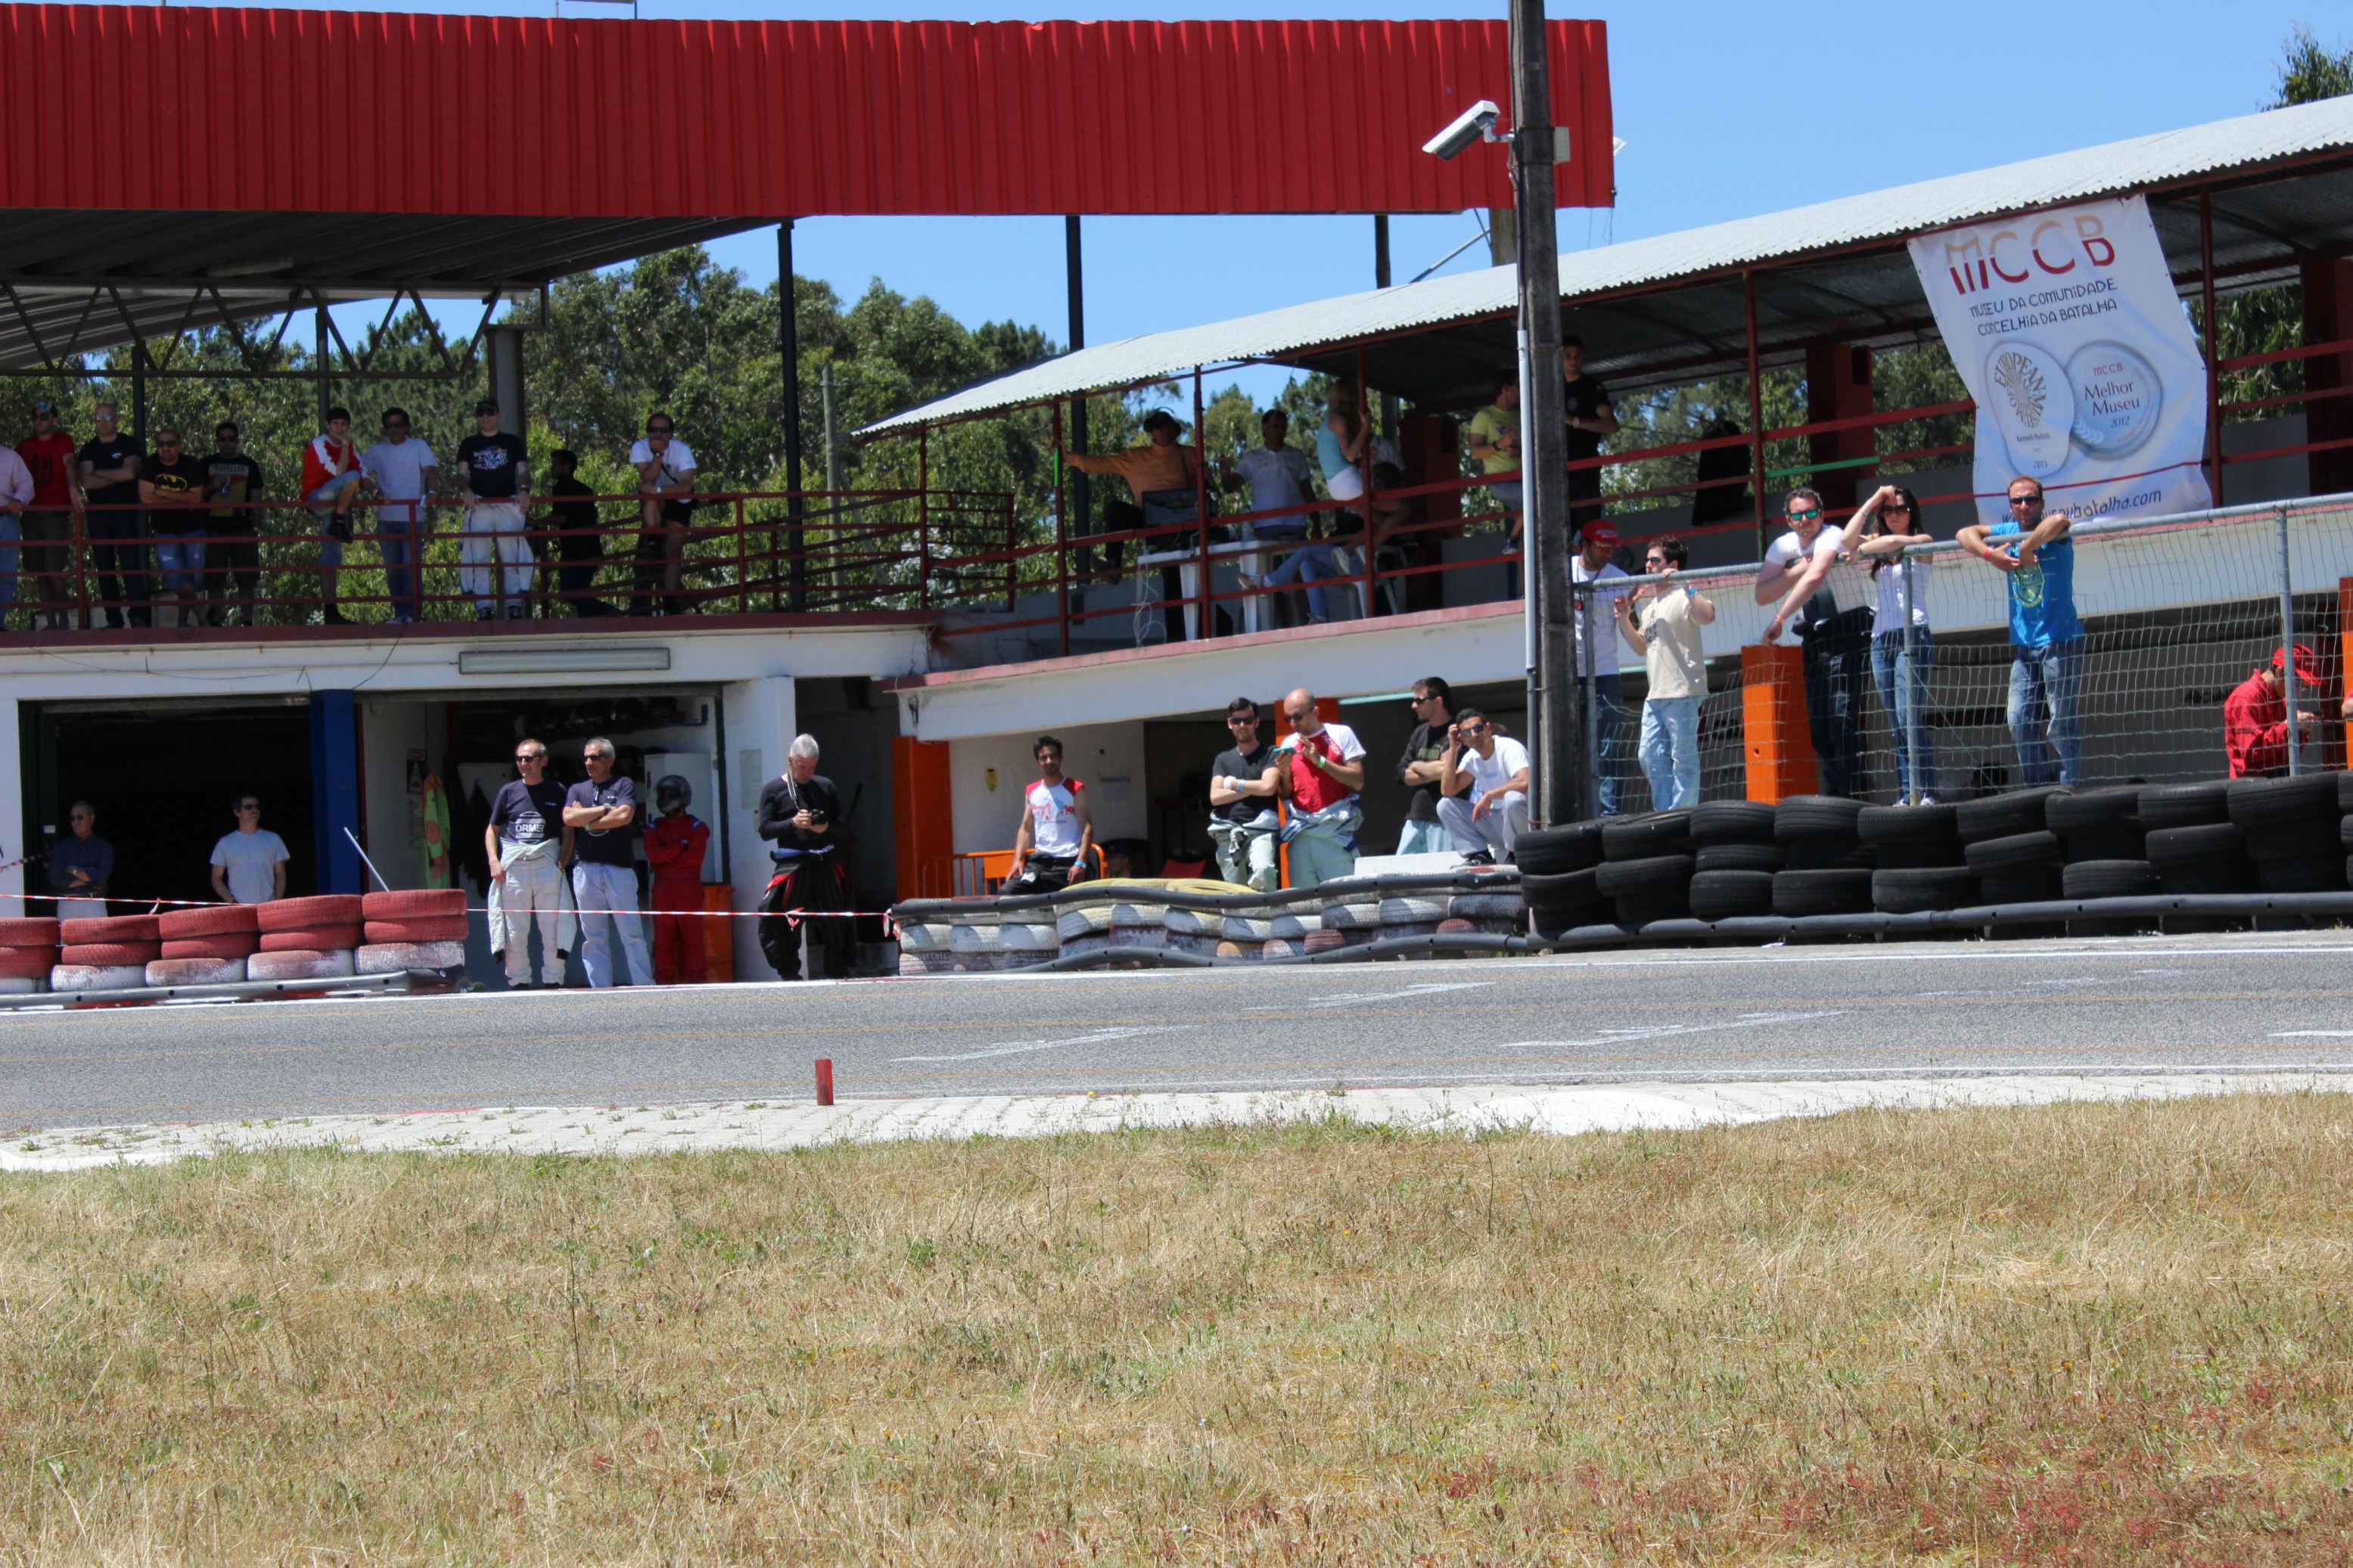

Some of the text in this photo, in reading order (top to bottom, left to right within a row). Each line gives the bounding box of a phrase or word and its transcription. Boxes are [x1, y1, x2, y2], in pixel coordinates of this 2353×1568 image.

[1945, 214, 2115, 296] MCCB
[1970, 278, 2118, 318] MUSEU DA COMUNIDADE
[1978, 298, 2118, 337] CONCELHIA DA BATALHA
[2084, 380, 2134, 401] Melhor
[2092, 398, 2140, 417] Museu
[2109, 416, 2130, 429] 2012
